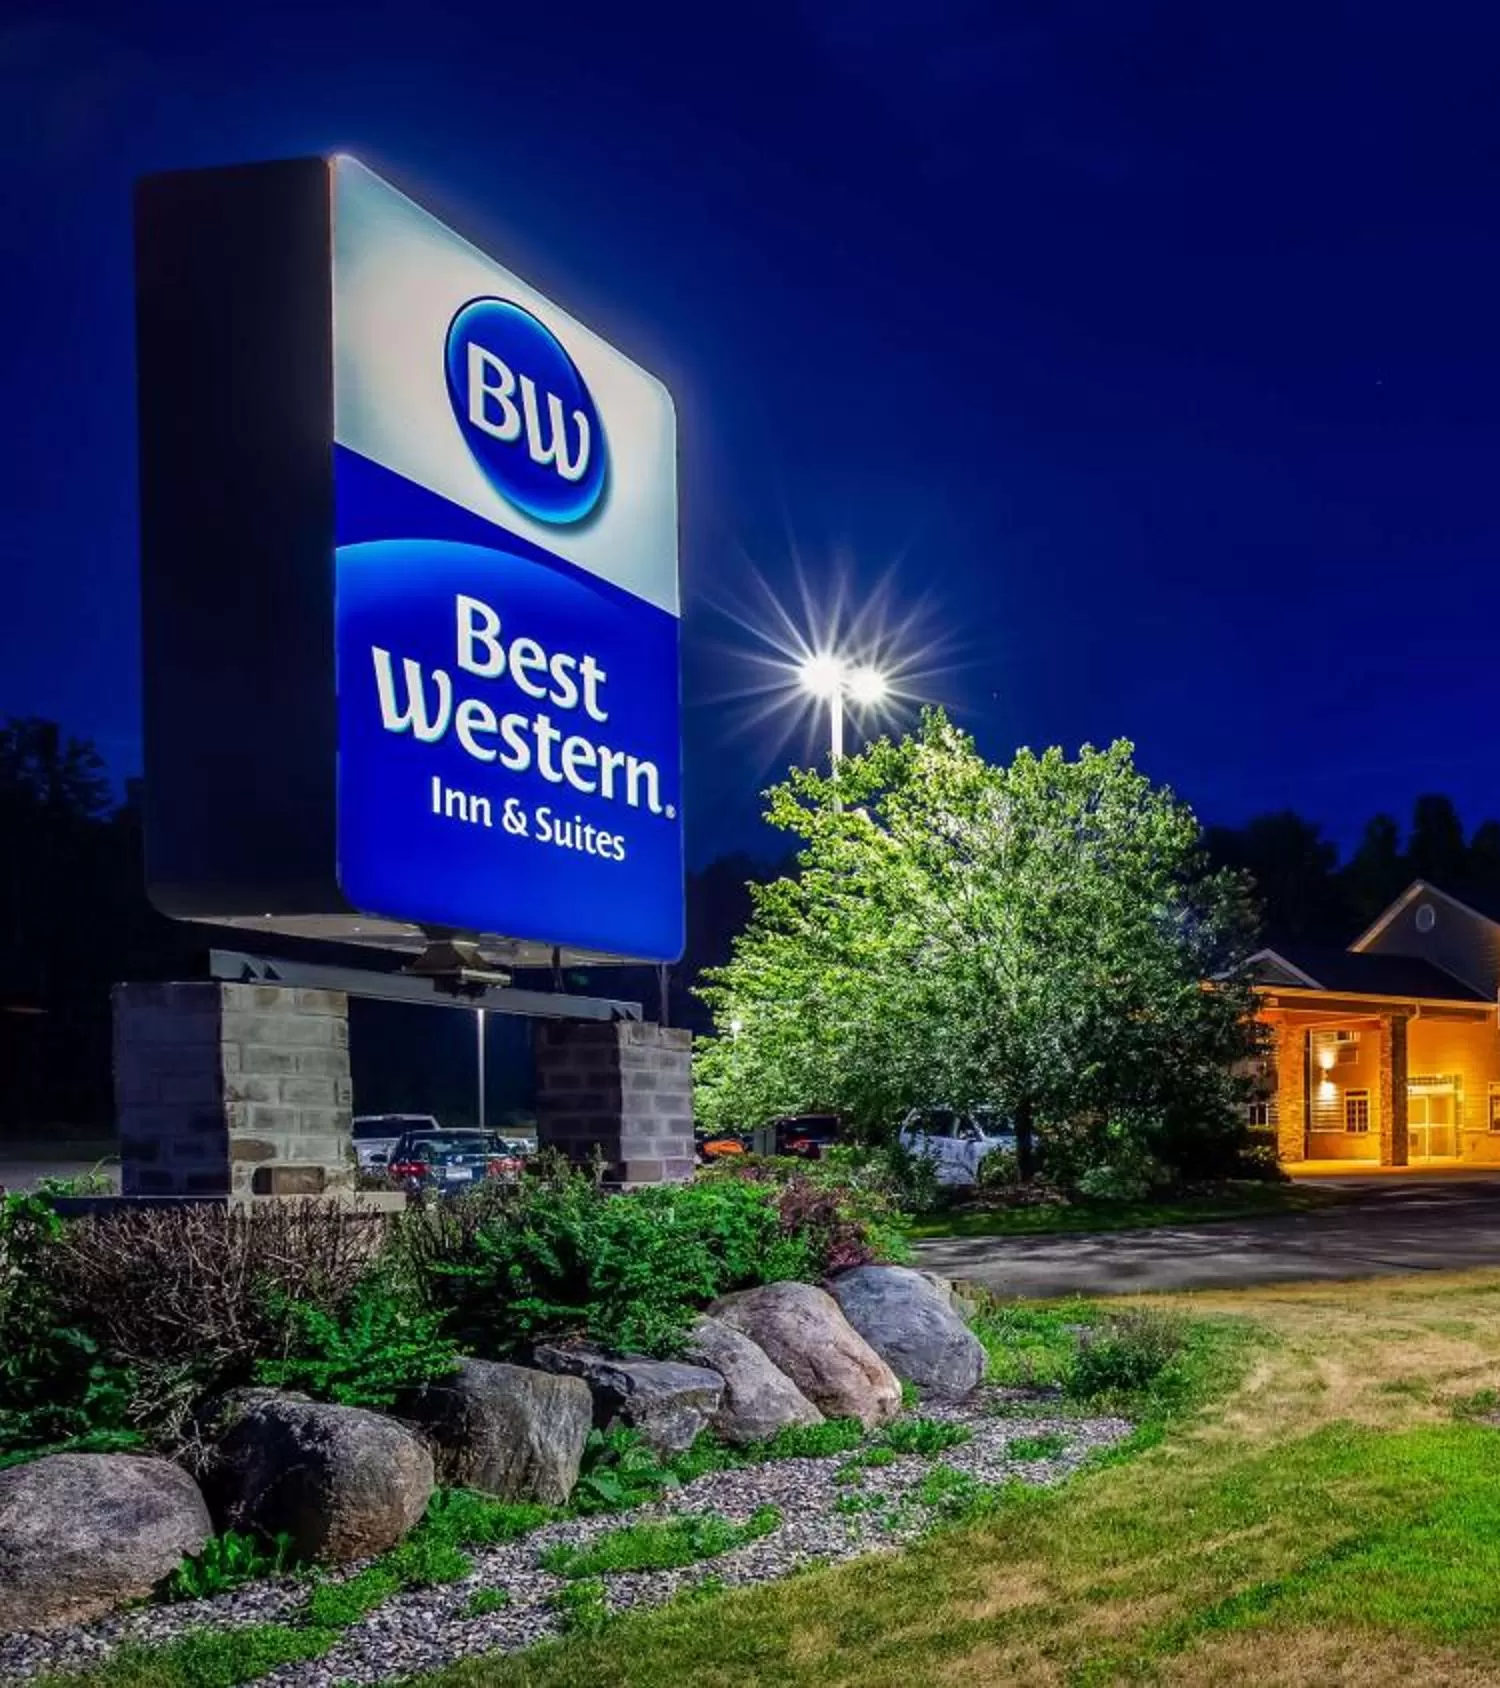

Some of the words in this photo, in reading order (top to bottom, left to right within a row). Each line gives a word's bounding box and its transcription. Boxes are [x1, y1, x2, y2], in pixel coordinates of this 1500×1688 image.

[467, 341, 590, 481] BW
[456, 593, 609, 722] Best
[431, 776, 494, 828] Inn
[501, 797, 530, 837] &
[535, 807, 626, 861] Suites
